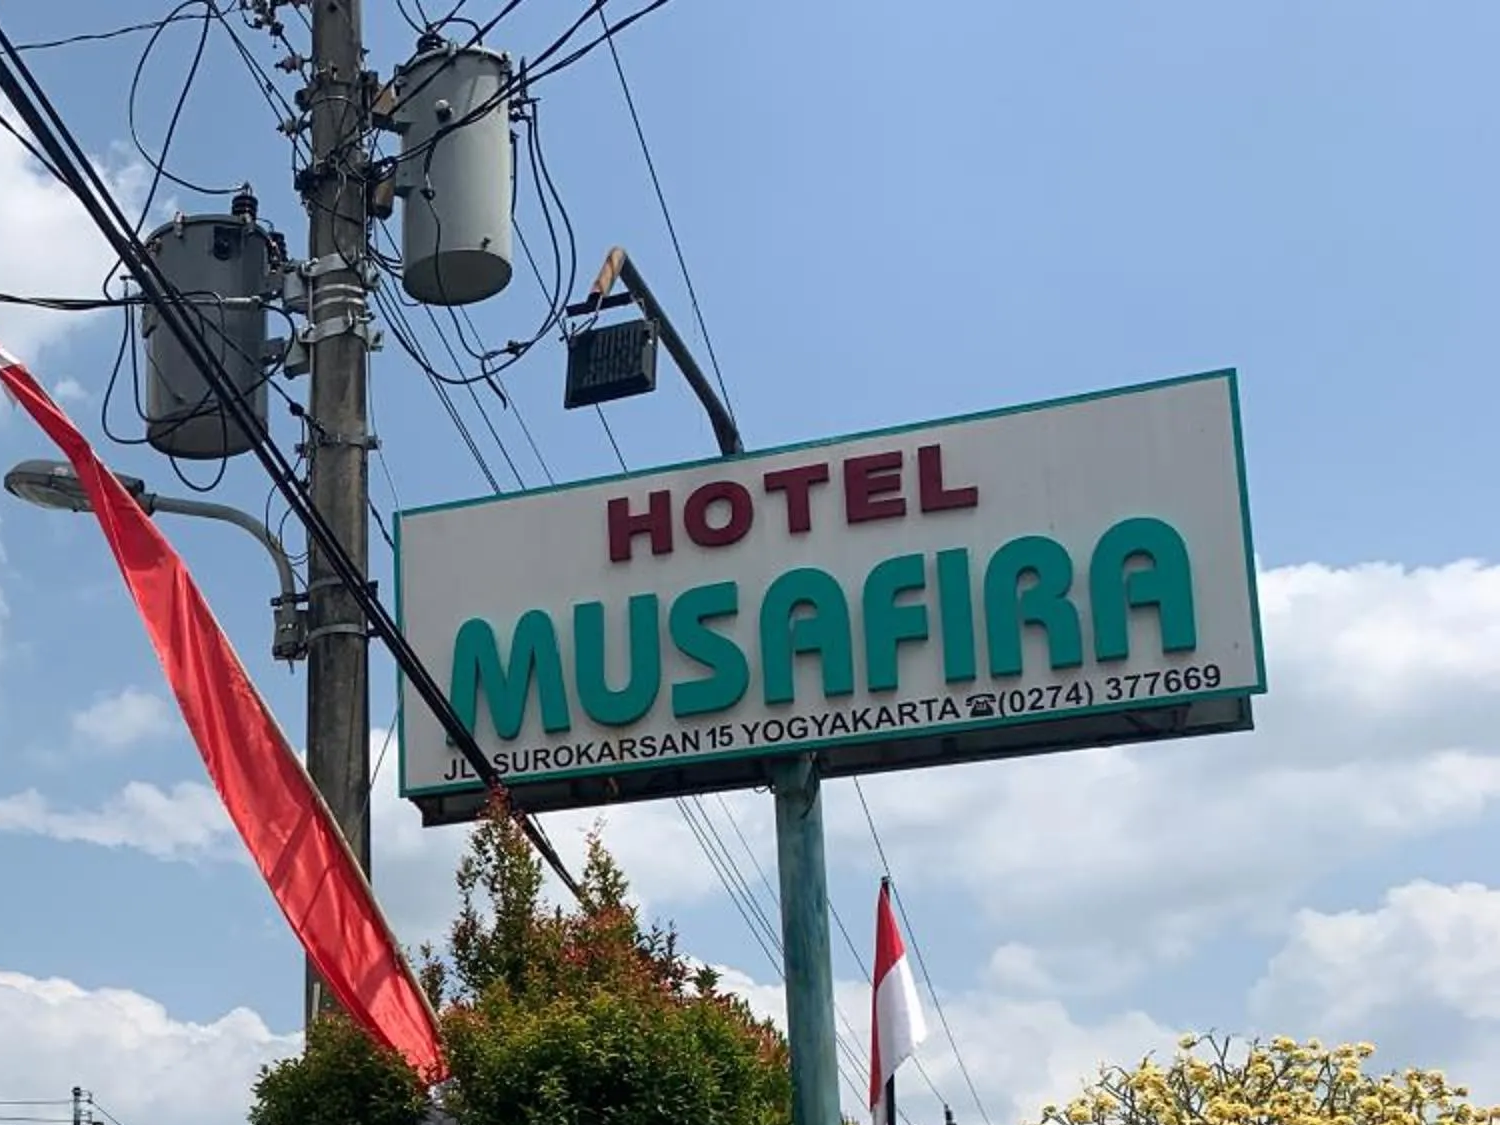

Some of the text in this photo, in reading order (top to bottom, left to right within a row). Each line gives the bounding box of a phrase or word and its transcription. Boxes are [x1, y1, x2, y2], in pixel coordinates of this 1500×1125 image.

[607, 444, 979, 563] HOTEL
[448, 517, 1197, 747] MUSAFIRA
[493, 730, 699, 775] SUROKARSAN
[705, 724, 734, 749] 15
[740, 696, 961, 745] YOGYAKARTA
[999, 679, 1094, 718] (0274)
[1105, 664, 1221, 701] 377669
